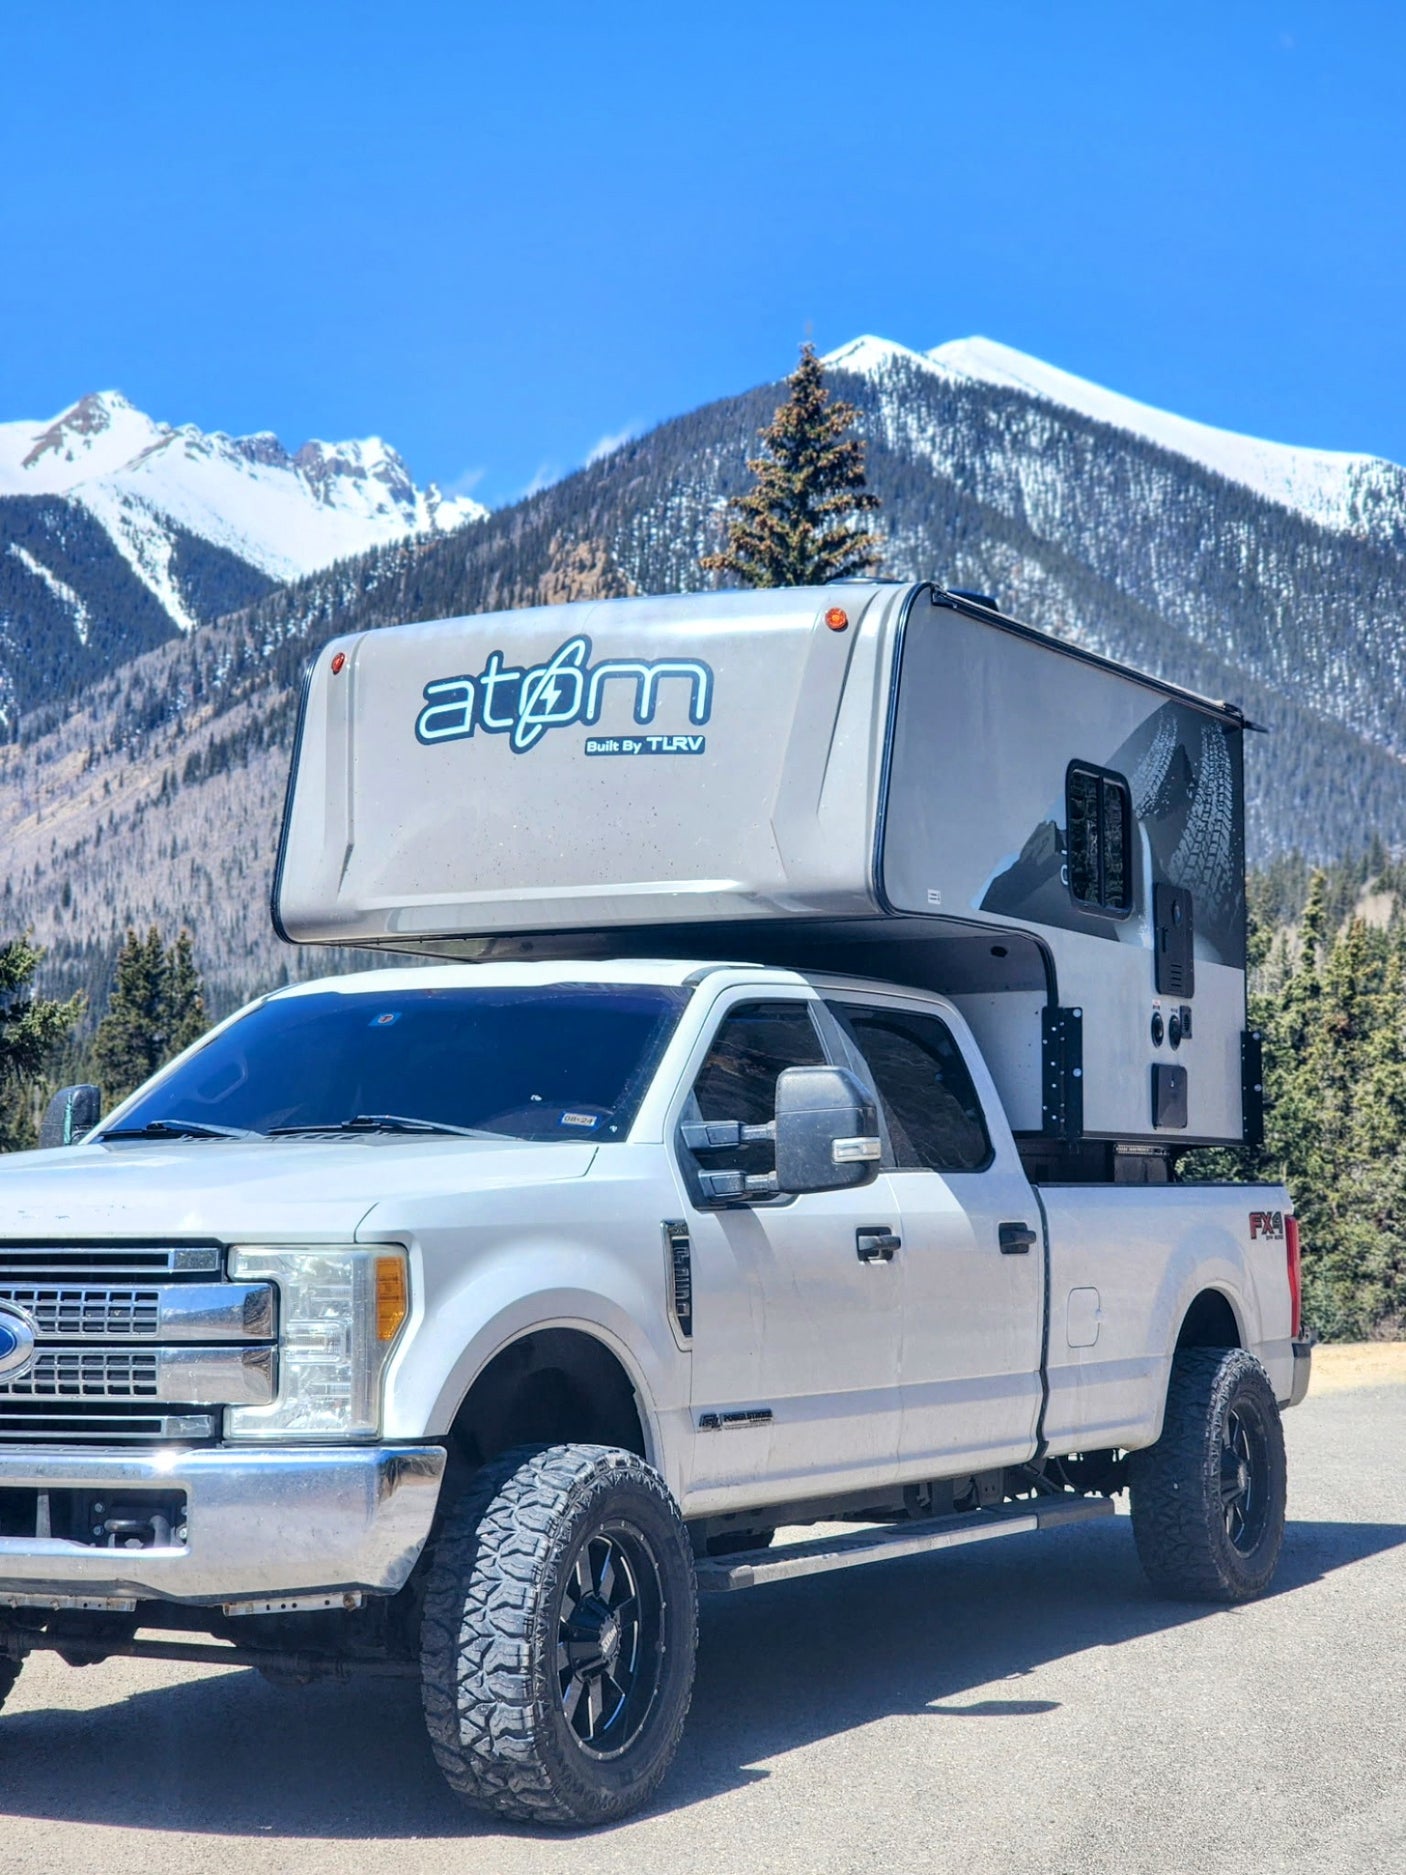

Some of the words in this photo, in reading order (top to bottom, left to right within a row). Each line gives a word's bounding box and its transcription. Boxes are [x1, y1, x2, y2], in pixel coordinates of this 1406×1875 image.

[416, 635, 713, 753] atom
[586, 740, 619, 753] Built
[622, 739, 643, 755] By
[646, 736, 704, 751] TLRV
[1249, 1211, 1283, 1240] FX4
